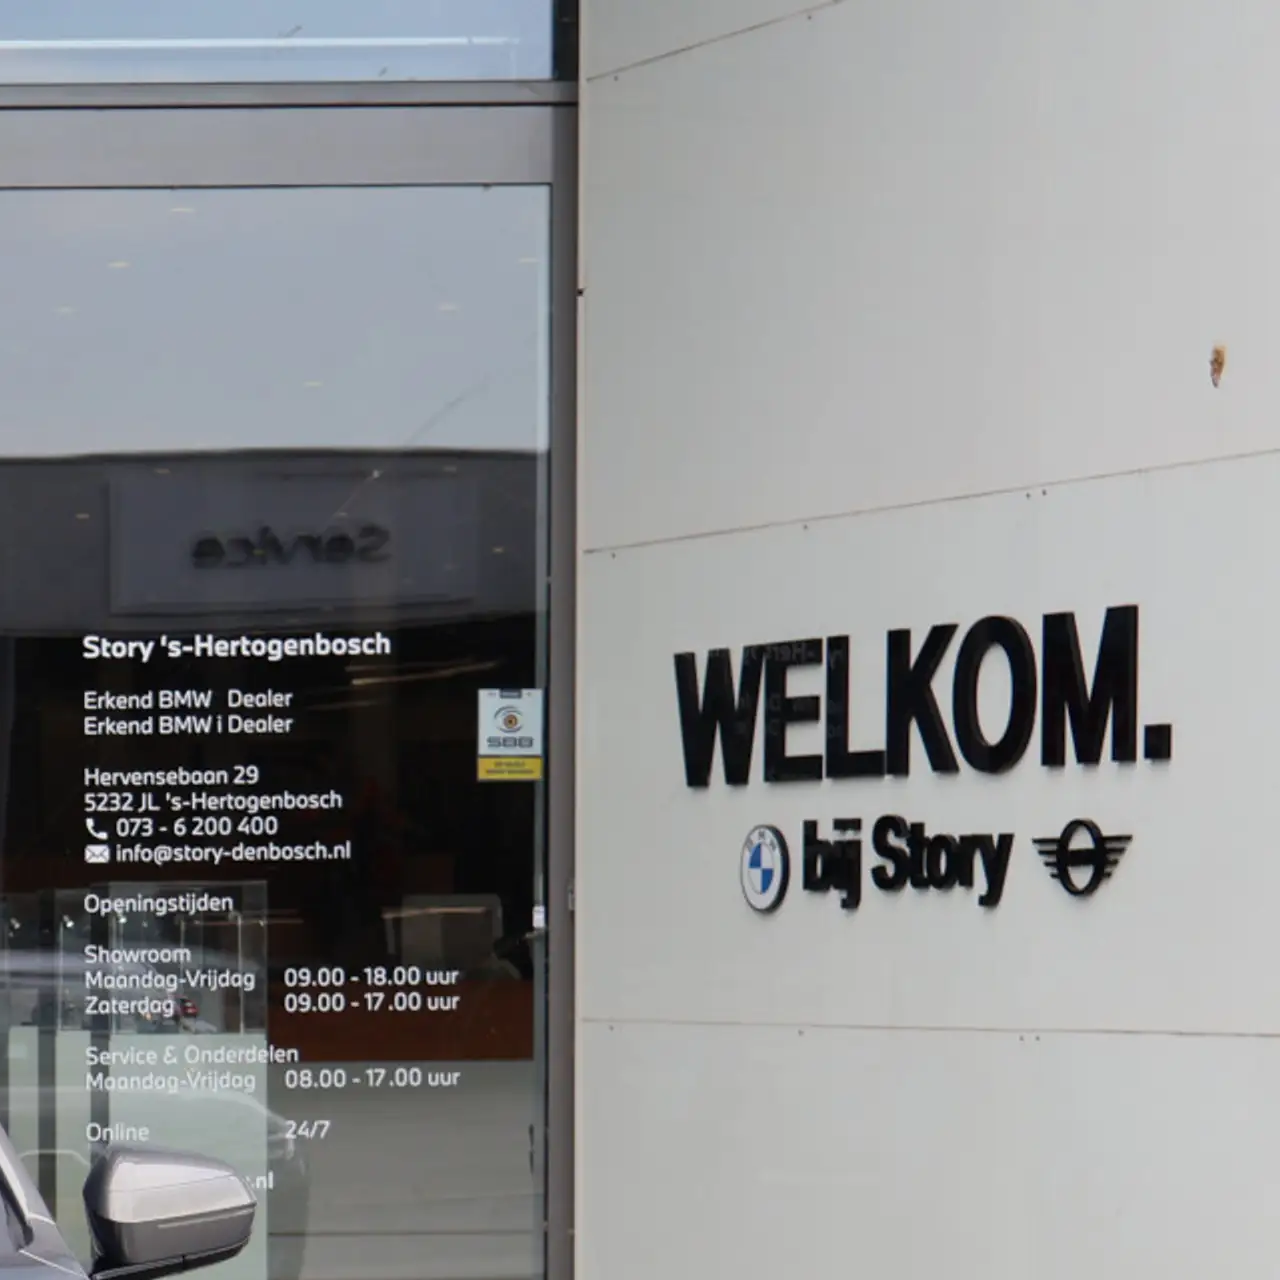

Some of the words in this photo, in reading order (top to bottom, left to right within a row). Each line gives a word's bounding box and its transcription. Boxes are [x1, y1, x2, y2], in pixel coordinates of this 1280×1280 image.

[82, 635, 154, 664] Story
[83, 690, 154, 710] Erkend
[158, 690, 213, 709] BMW
[227, 688, 294, 708] Dealer
[673, 604, 1172, 787] WELKOM.
[83, 716, 154, 736] Erkend
[158, 715, 213, 735] BMW
[216, 714, 223, 734] i
[227, 713, 294, 734] Dealer
[83, 766, 229, 787] Hervensebaan
[232, 765, 260, 785] 29
[84, 792, 134, 813] 5232
[137, 792, 161, 814] JL
[115, 817, 154, 837] 073
[173, 817, 188, 837] 6
[191, 816, 233, 836] 200
[236, 815, 279, 836] 400
[115, 839, 352, 866] info@story-denbosch.nl
[871, 814, 1015, 906] Story
[83, 894, 235, 919] Openingstijden
[83, 944, 192, 965] Showroom
[84, 968, 256, 993] Maandag-Vrijdag
[283, 966, 346, 988] 09.00
[363, 966, 422, 987] 18.00
[425, 970, 460, 986] uur
[84, 994, 176, 1018] Zaterdag
[284, 992, 346, 1013] 09.00
[363, 991, 422, 1012] 17.00
[426, 995, 461, 1012] uur
[86, 1046, 157, 1066] Service
[163, 1046, 177, 1065] &
[185, 1044, 300, 1064] Onderdelen
[85, 1070, 256, 1094] Maandag-Vrijdag
[284, 1068, 347, 1089] 08.00
[365, 1067, 423, 1088] 17.00
[427, 1071, 461, 1087] uur
[86, 1121, 149, 1143] Online
[284, 1120, 331, 1141] 24/7
